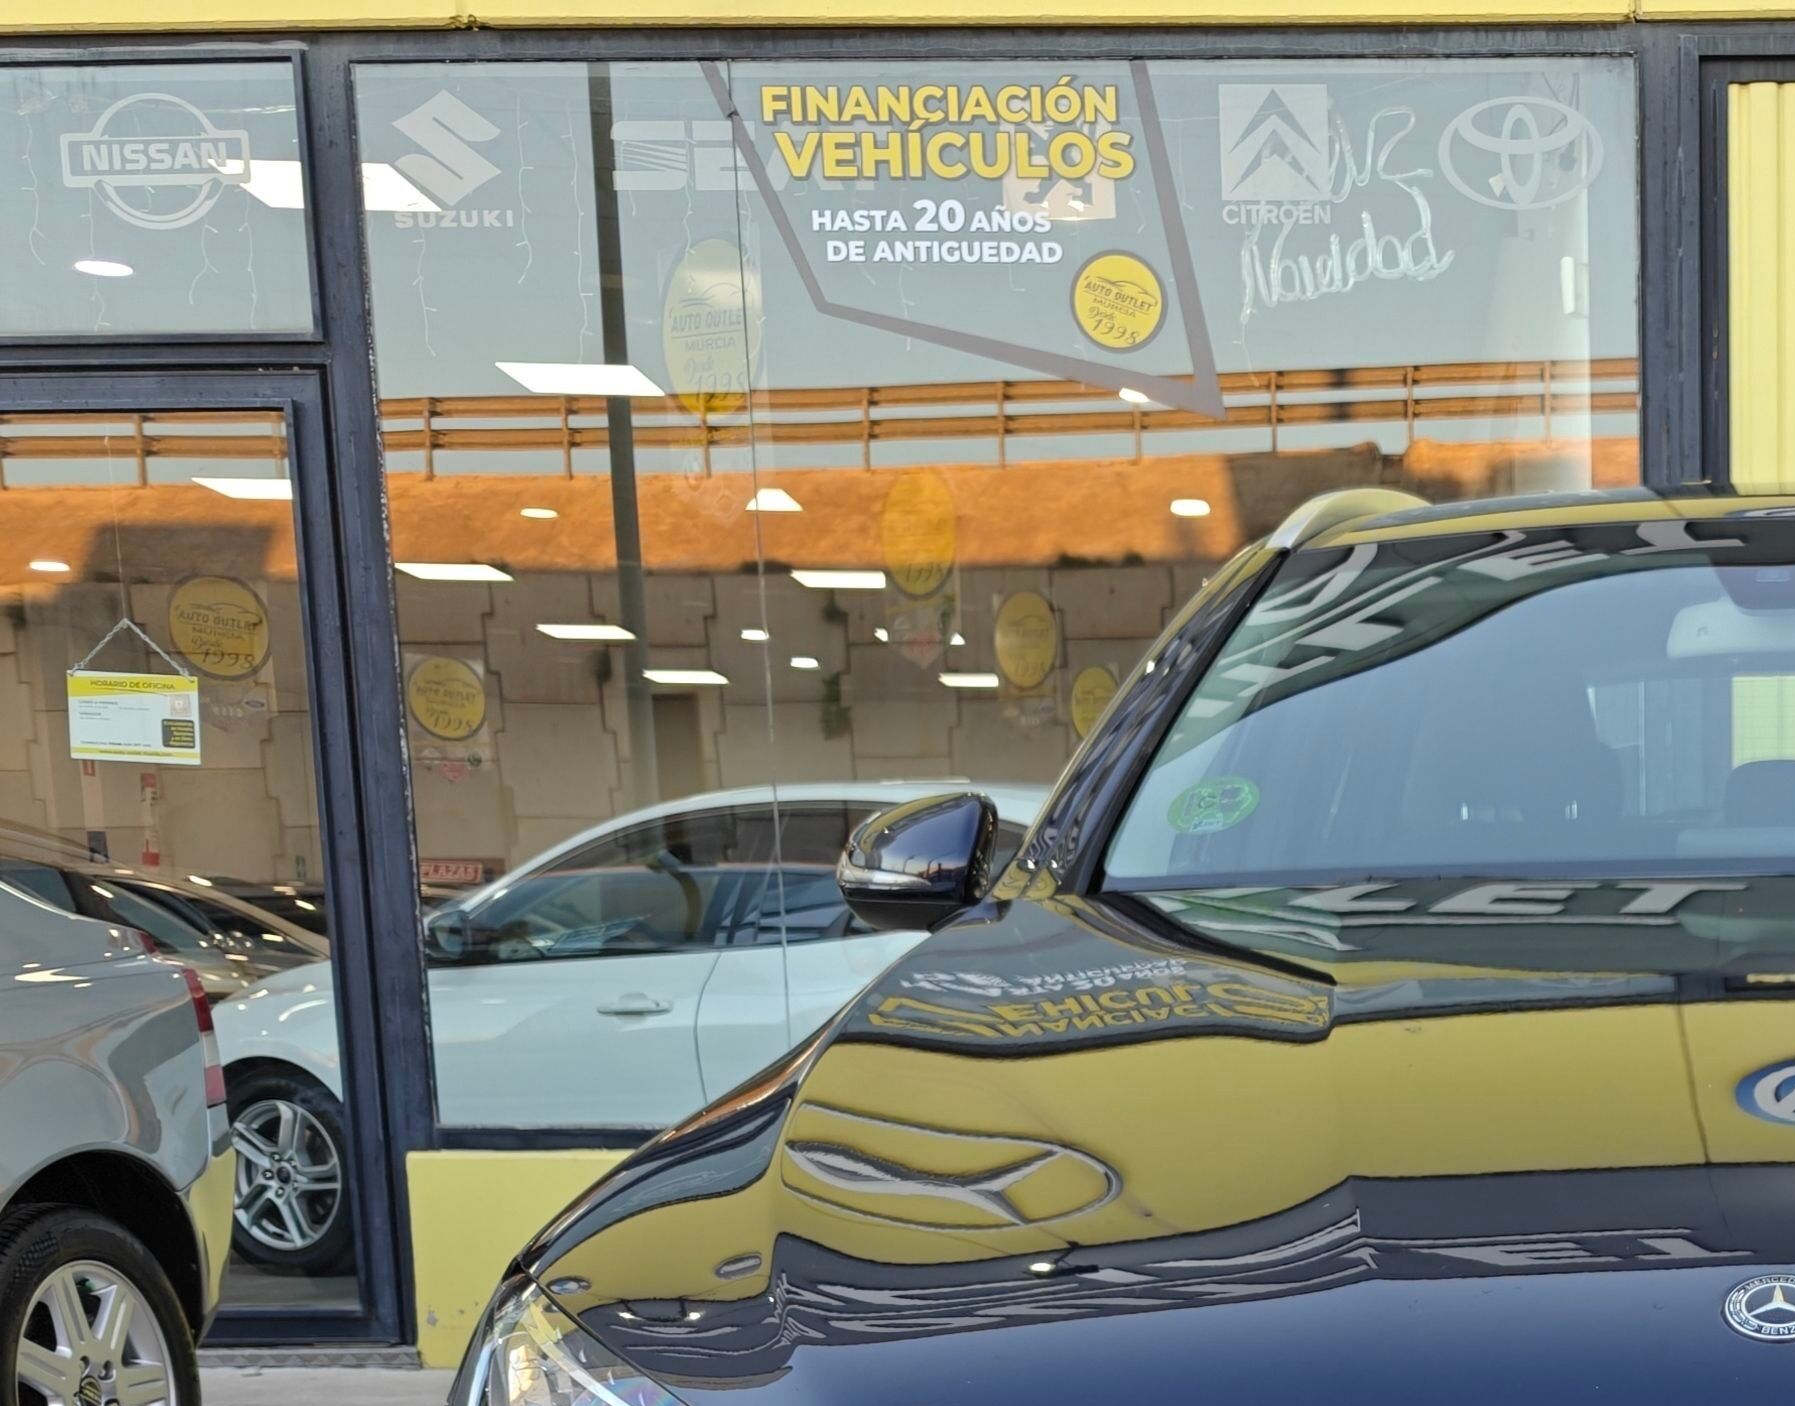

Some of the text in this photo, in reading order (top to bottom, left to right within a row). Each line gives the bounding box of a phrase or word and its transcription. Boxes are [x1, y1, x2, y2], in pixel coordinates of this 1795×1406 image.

[761, 76, 1117, 123] FINANCIACIÓN
[82, 142, 227, 172] NISSAN
[773, 125, 1136, 180] VEHÍCULOS
[394, 209, 515, 230] SUZUKI
[811, 199, 1052, 234] HASTA 20 AÑOS
[1221, 201, 1332, 226] CITROËN
[826, 240, 1064, 265] DE ANTIGUEDAD
[1084, 281, 1153, 312] AUTO OUTLET
[671, 313, 701, 333] AUTO
[1092, 319, 1141, 344] 1998
[202, 647, 256, 669] 1998
